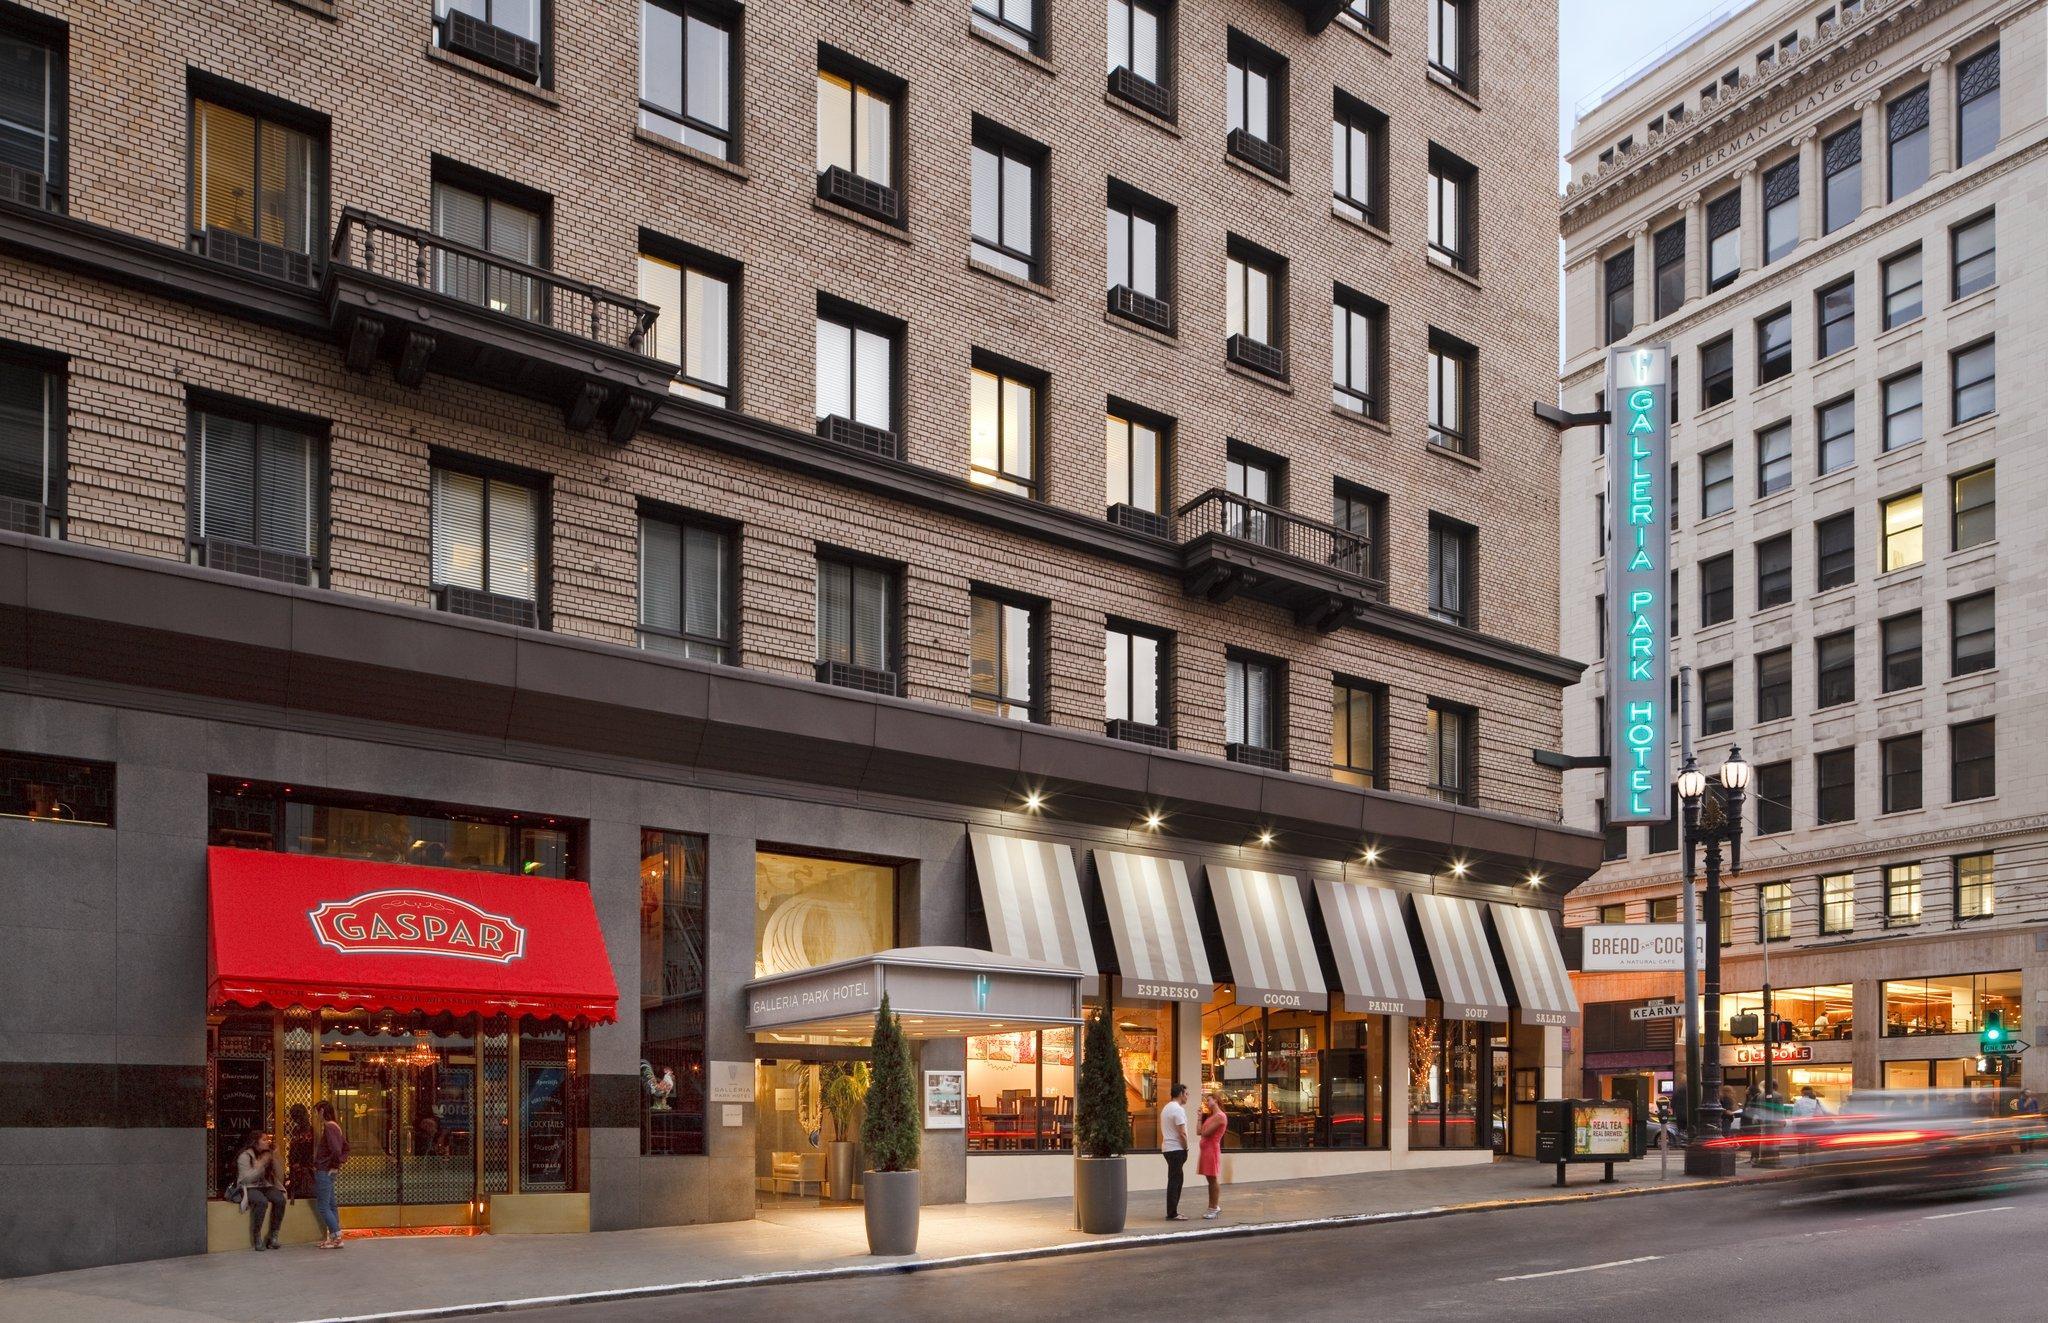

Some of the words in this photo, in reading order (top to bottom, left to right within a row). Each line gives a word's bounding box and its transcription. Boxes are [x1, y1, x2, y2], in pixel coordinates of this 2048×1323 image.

[1779, 87, 1828, 124] CLAY
[1833, 80, 1846, 93] &
[1627, 390, 1655, 571] GALLERIA
[1628, 591, 1655, 681] PARK
[1628, 701, 1654, 813] HOTEL
[333, 912, 504, 951] GASPAR
[1592, 938, 1639, 955] BREAD
[1641, 941, 1655, 950] AND
[1654, 937, 1704, 954] COCA
[753, 994, 799, 1014] GALLERIA
[802, 988, 829, 1005] PARK
[833, 982, 869, 1001] HOTEL
[1137, 984, 1199, 999] ESPRESSO
[1263, 993, 1300, 1006] COCOA
[1368, 1001, 1404, 1013] PANINI
[1465, 1008, 1489, 1019] SOUP
[1633, 1006, 1681, 1018] KEARNY
[1535, 1013, 1567, 1024] SALADS
[230, 1118, 251, 1129] VIN
[529, 1120, 564, 1129] COCKTAILS
[1593, 1121, 1608, 1129] REAL
